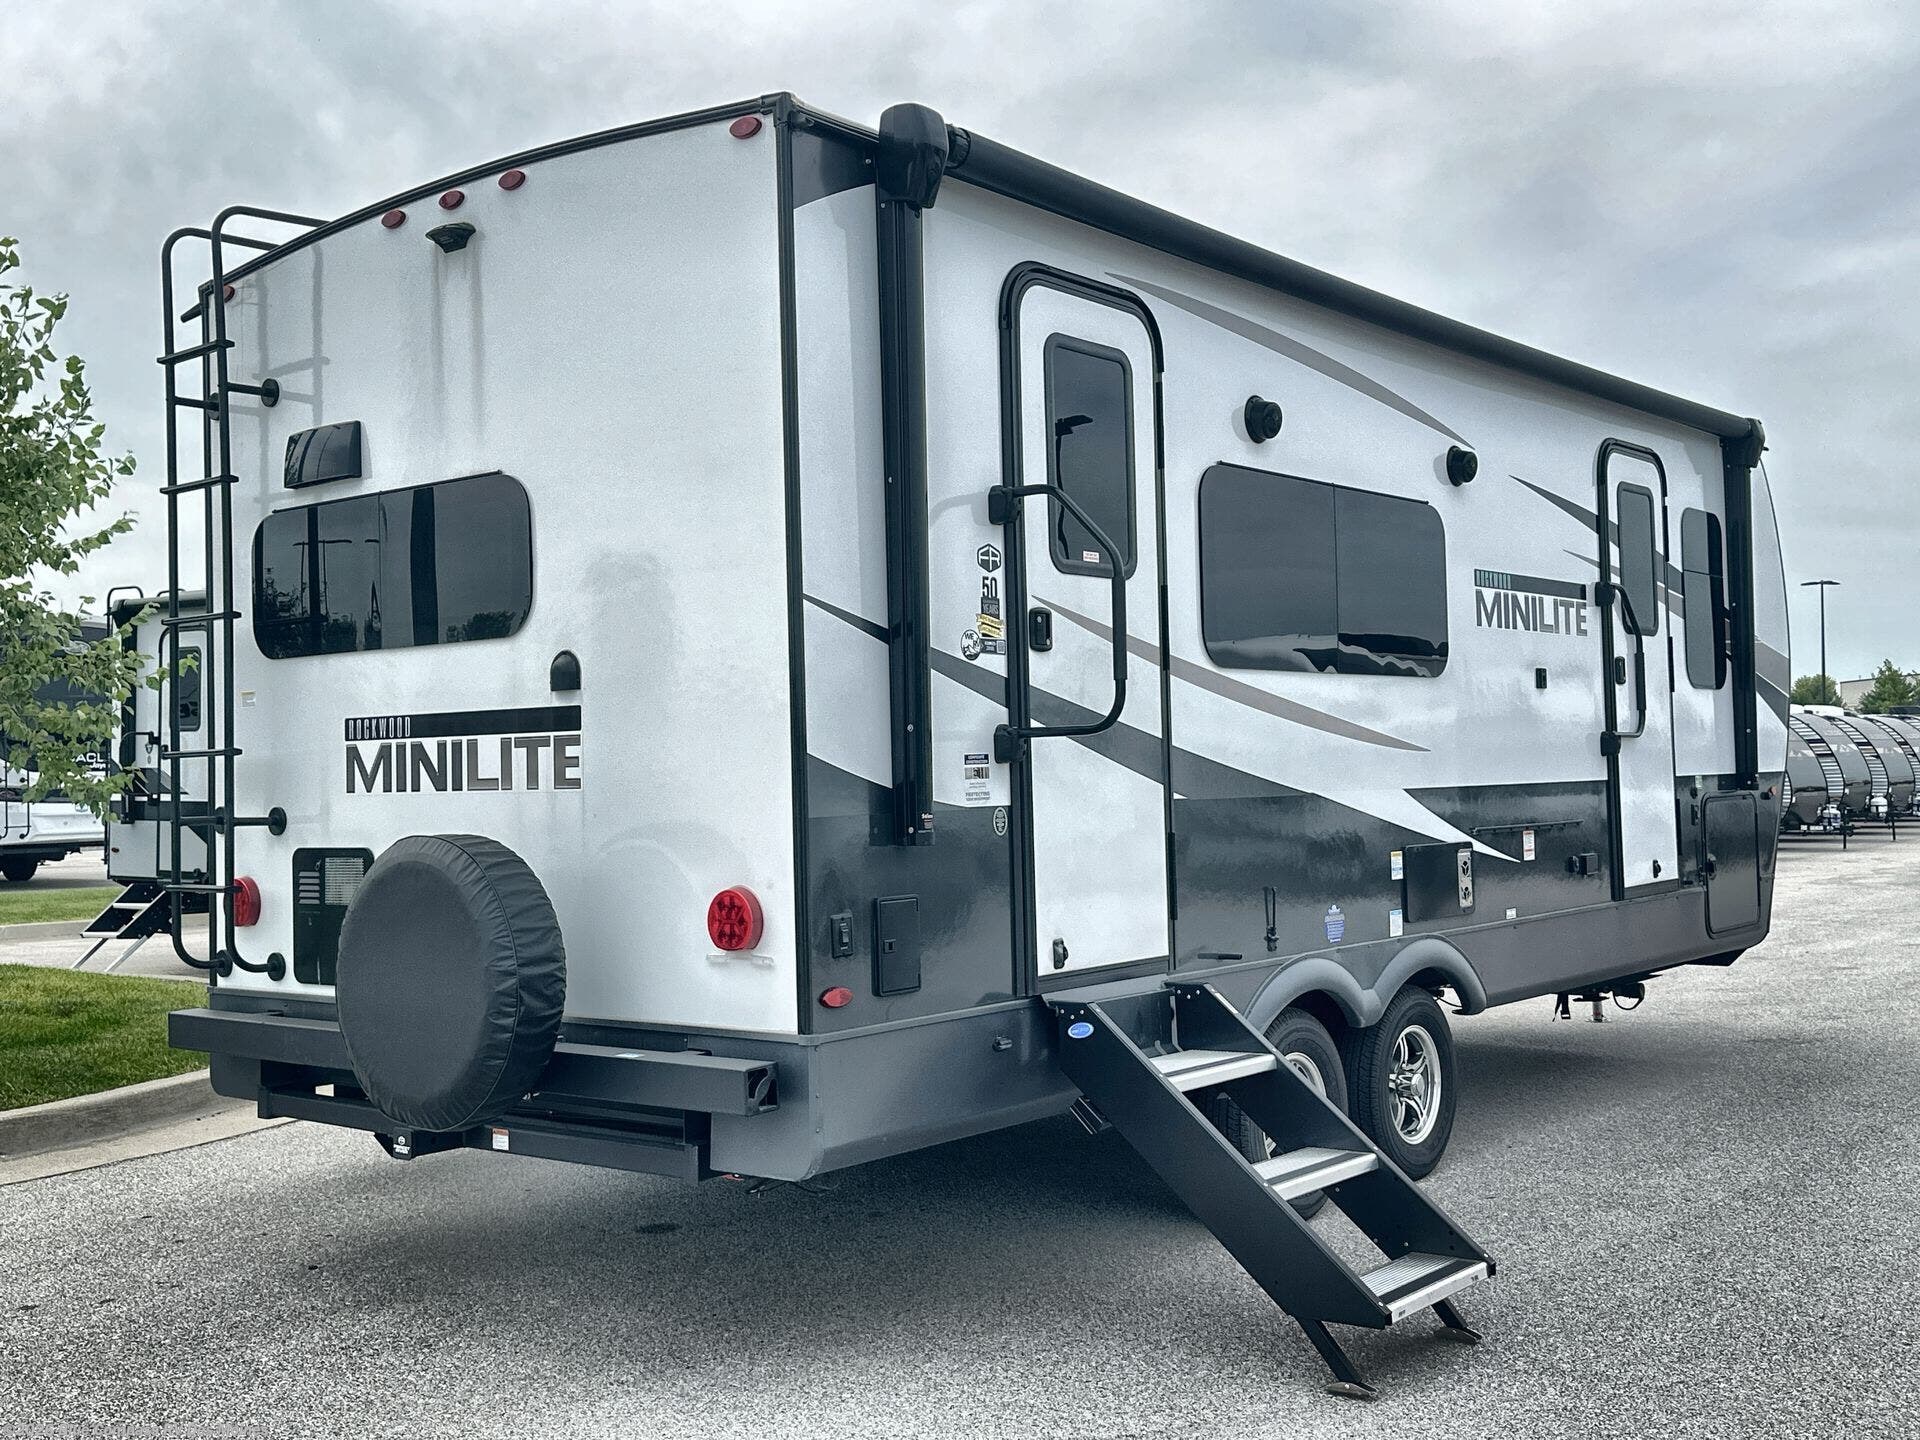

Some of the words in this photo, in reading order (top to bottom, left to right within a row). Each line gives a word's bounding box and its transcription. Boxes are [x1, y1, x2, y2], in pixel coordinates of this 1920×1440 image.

[982, 575, 998, 598] 50
[1475, 588, 1588, 636] MINILITE
[348, 716, 411, 740] ROCKWOOD
[346, 734, 582, 793] MINILITE
